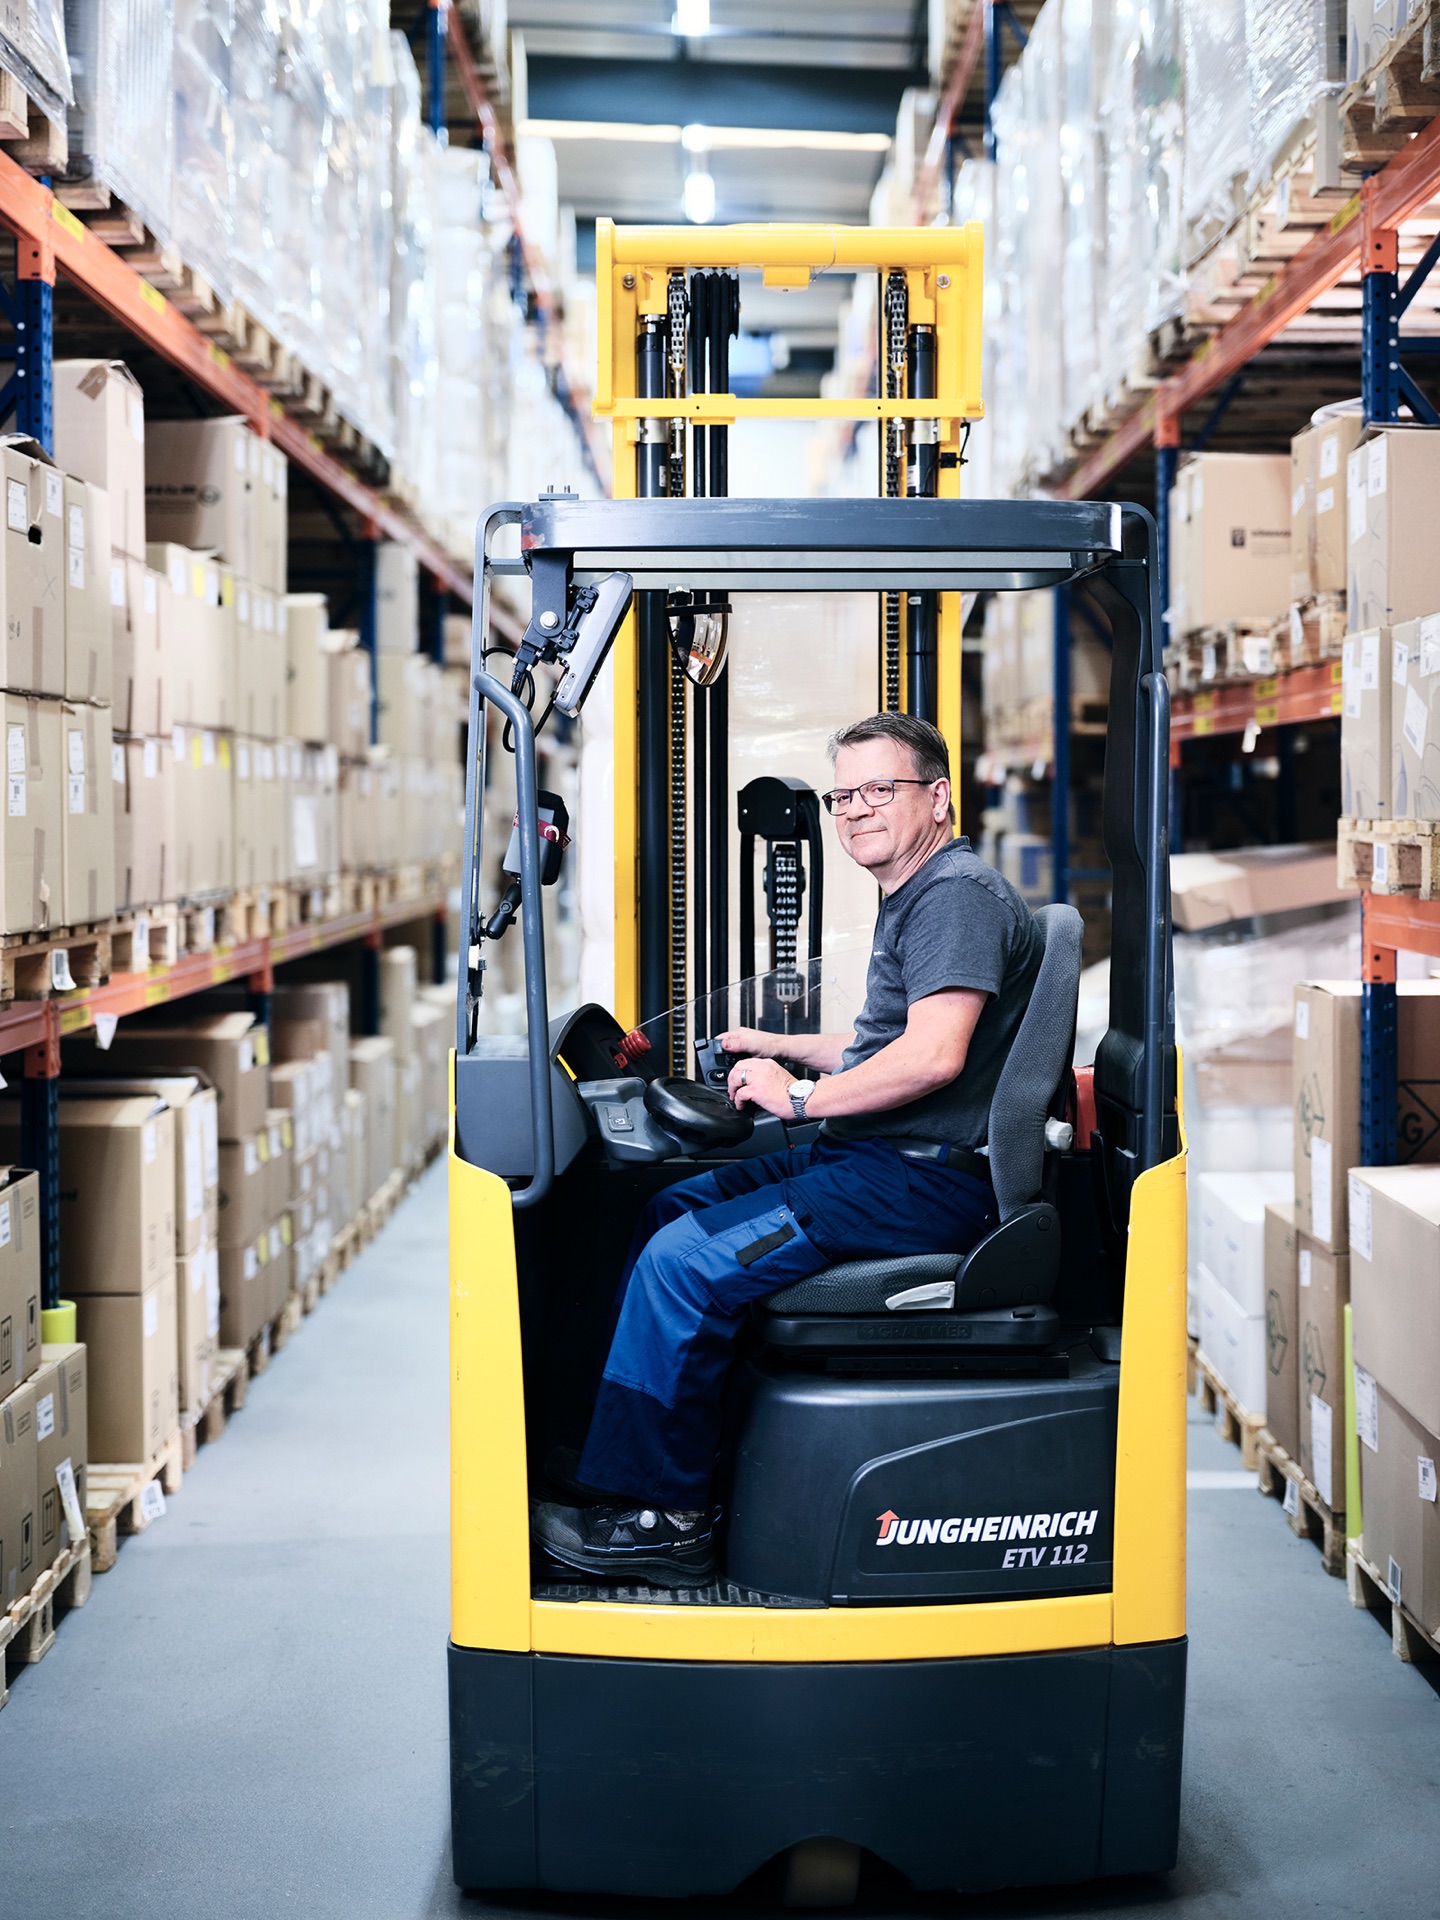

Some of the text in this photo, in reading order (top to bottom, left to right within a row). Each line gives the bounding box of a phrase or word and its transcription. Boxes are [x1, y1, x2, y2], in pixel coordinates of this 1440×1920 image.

[876, 1510, 1098, 1546] JUNGHEINRICH
[1002, 1543, 1088, 1569] ETV 112
